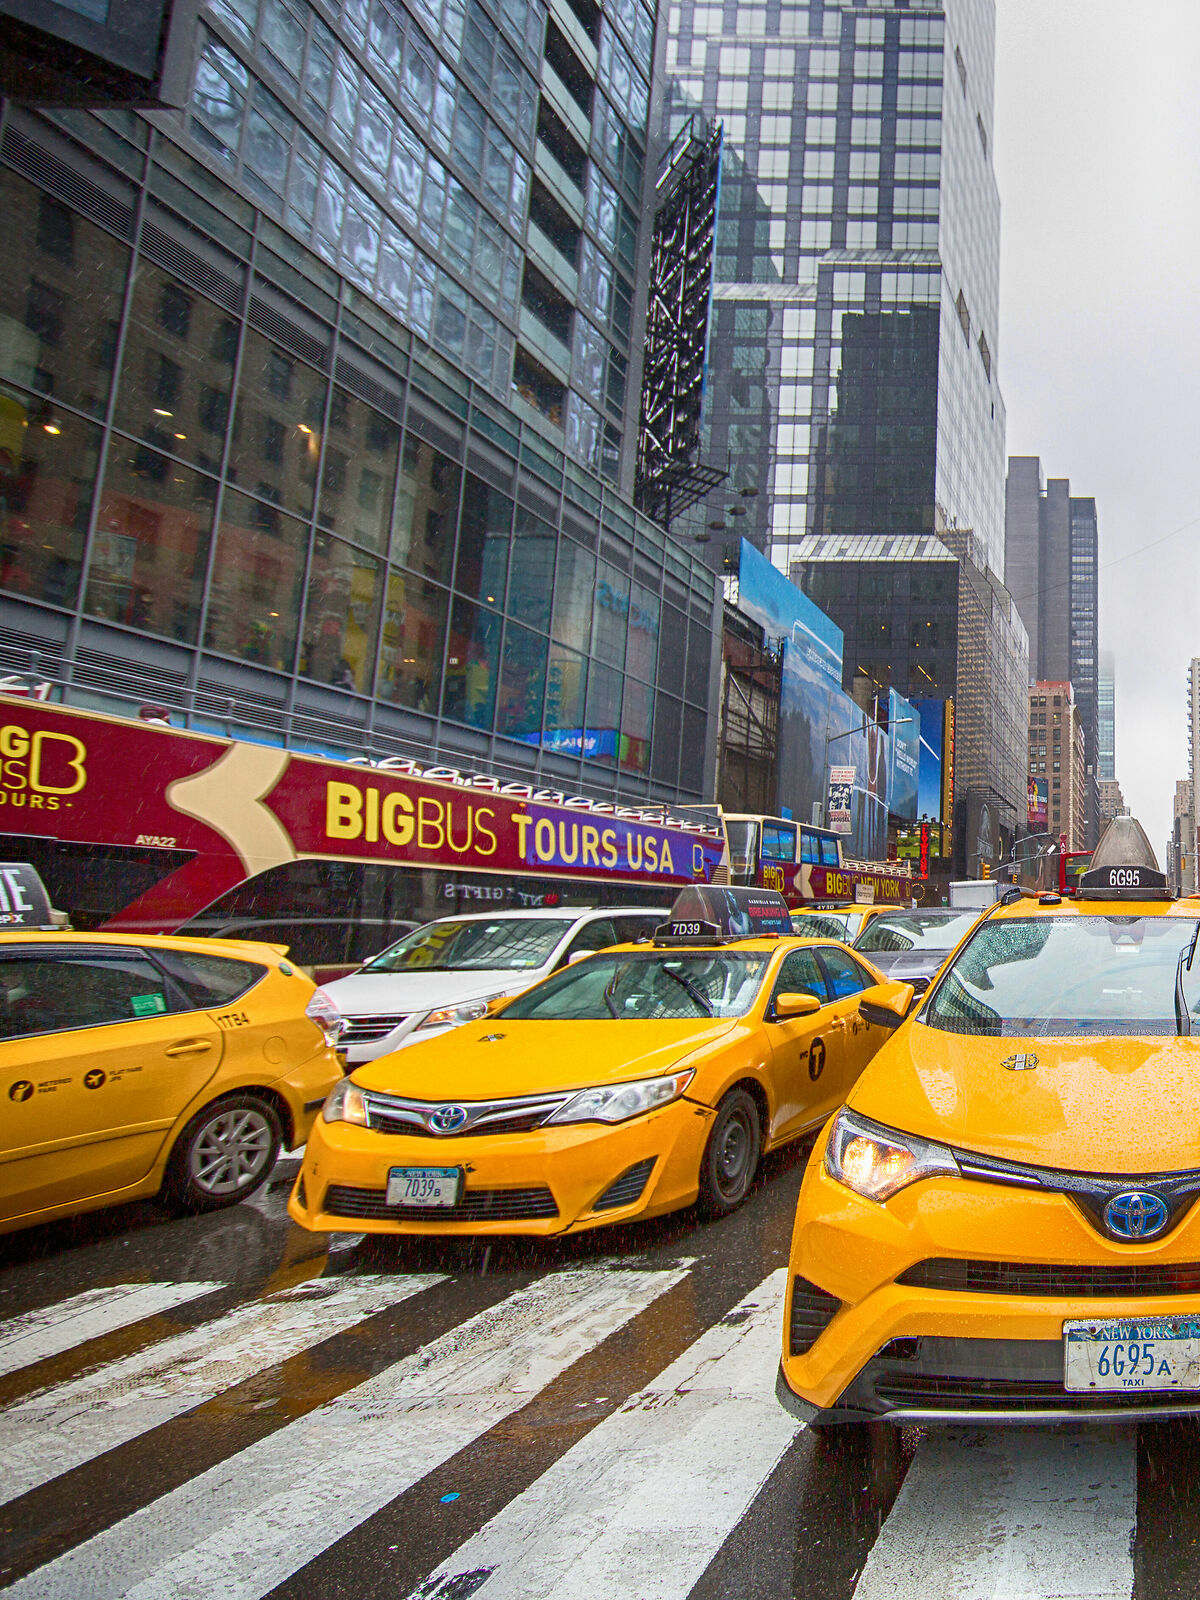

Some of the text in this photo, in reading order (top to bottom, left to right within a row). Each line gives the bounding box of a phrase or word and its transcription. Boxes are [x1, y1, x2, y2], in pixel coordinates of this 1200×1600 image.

[135, 834, 177, 848] AYA22
[511, 813, 619, 869] TOURS
[626, 833, 675, 875] USA
[763, 865, 776, 879] BIG
[1109, 869, 1140, 886] 6G95
[879, 875, 900, 897] YORK
[748, 907, 781, 918] BREAKING
[672, 923, 700, 935] 7D39
[1100, 1324, 1172, 1340] NEW YORK
[1122, 1379, 1145, 1387] TAXI
